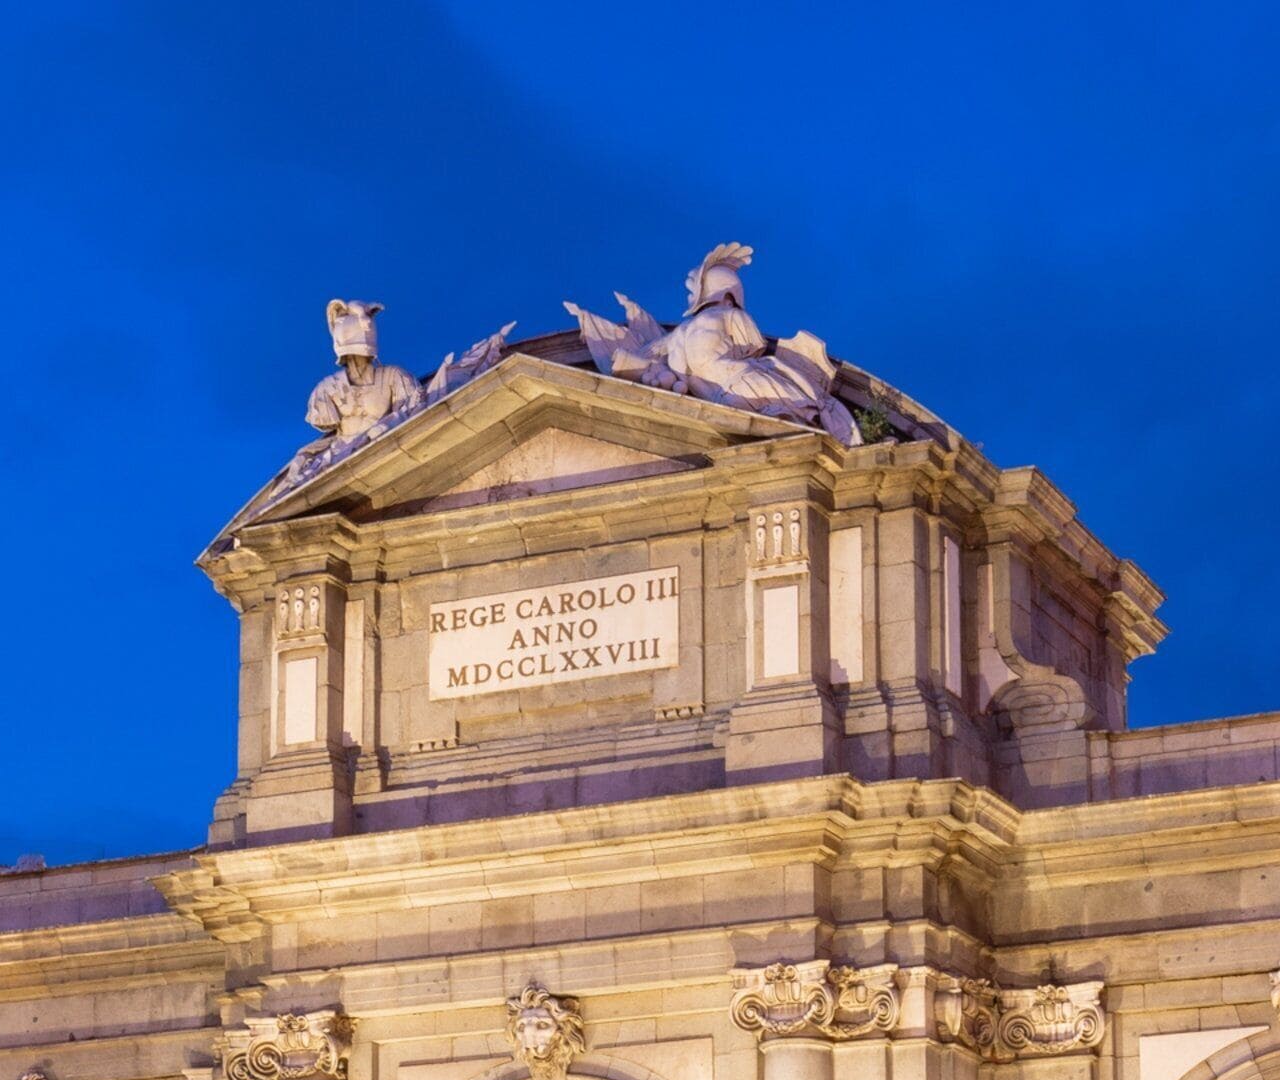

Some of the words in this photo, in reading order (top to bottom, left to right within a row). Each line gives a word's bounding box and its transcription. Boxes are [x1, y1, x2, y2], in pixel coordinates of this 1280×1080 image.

[430, 603, 506, 634] REGE
[516, 583, 636, 619] CAROLO
[646, 576, 678, 600] III
[507, 618, 598, 650] ANNO
[447, 637, 661, 687] MDCCLXXVIII
